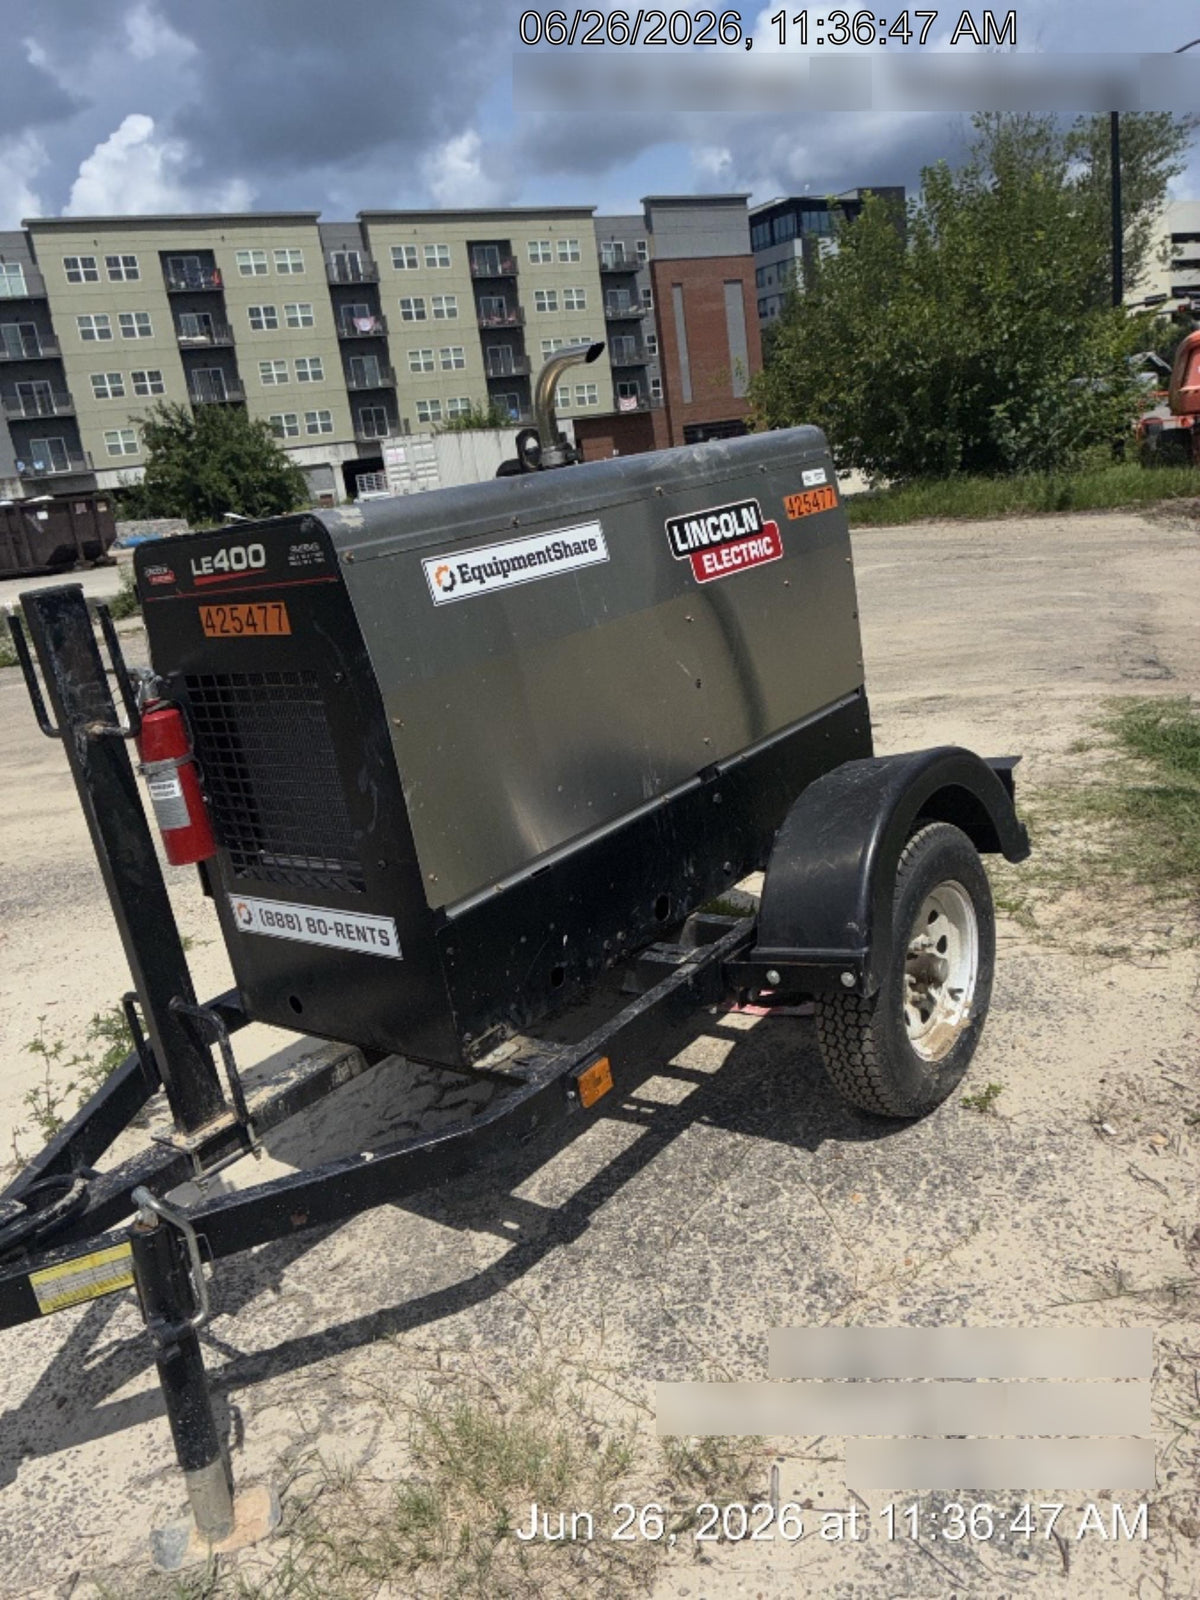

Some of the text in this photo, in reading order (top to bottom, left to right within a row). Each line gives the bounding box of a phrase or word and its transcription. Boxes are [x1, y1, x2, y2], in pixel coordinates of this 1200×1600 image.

[787, 486, 834, 518] 425477
[672, 506, 760, 552] LINCOLN
[190, 543, 266, 576] LE400
[456, 537, 598, 585] EquipmentShare
[702, 536, 775, 574] ELECTRIC
[205, 604, 283, 634] 425477
[259, 908, 302, 932] (888)
